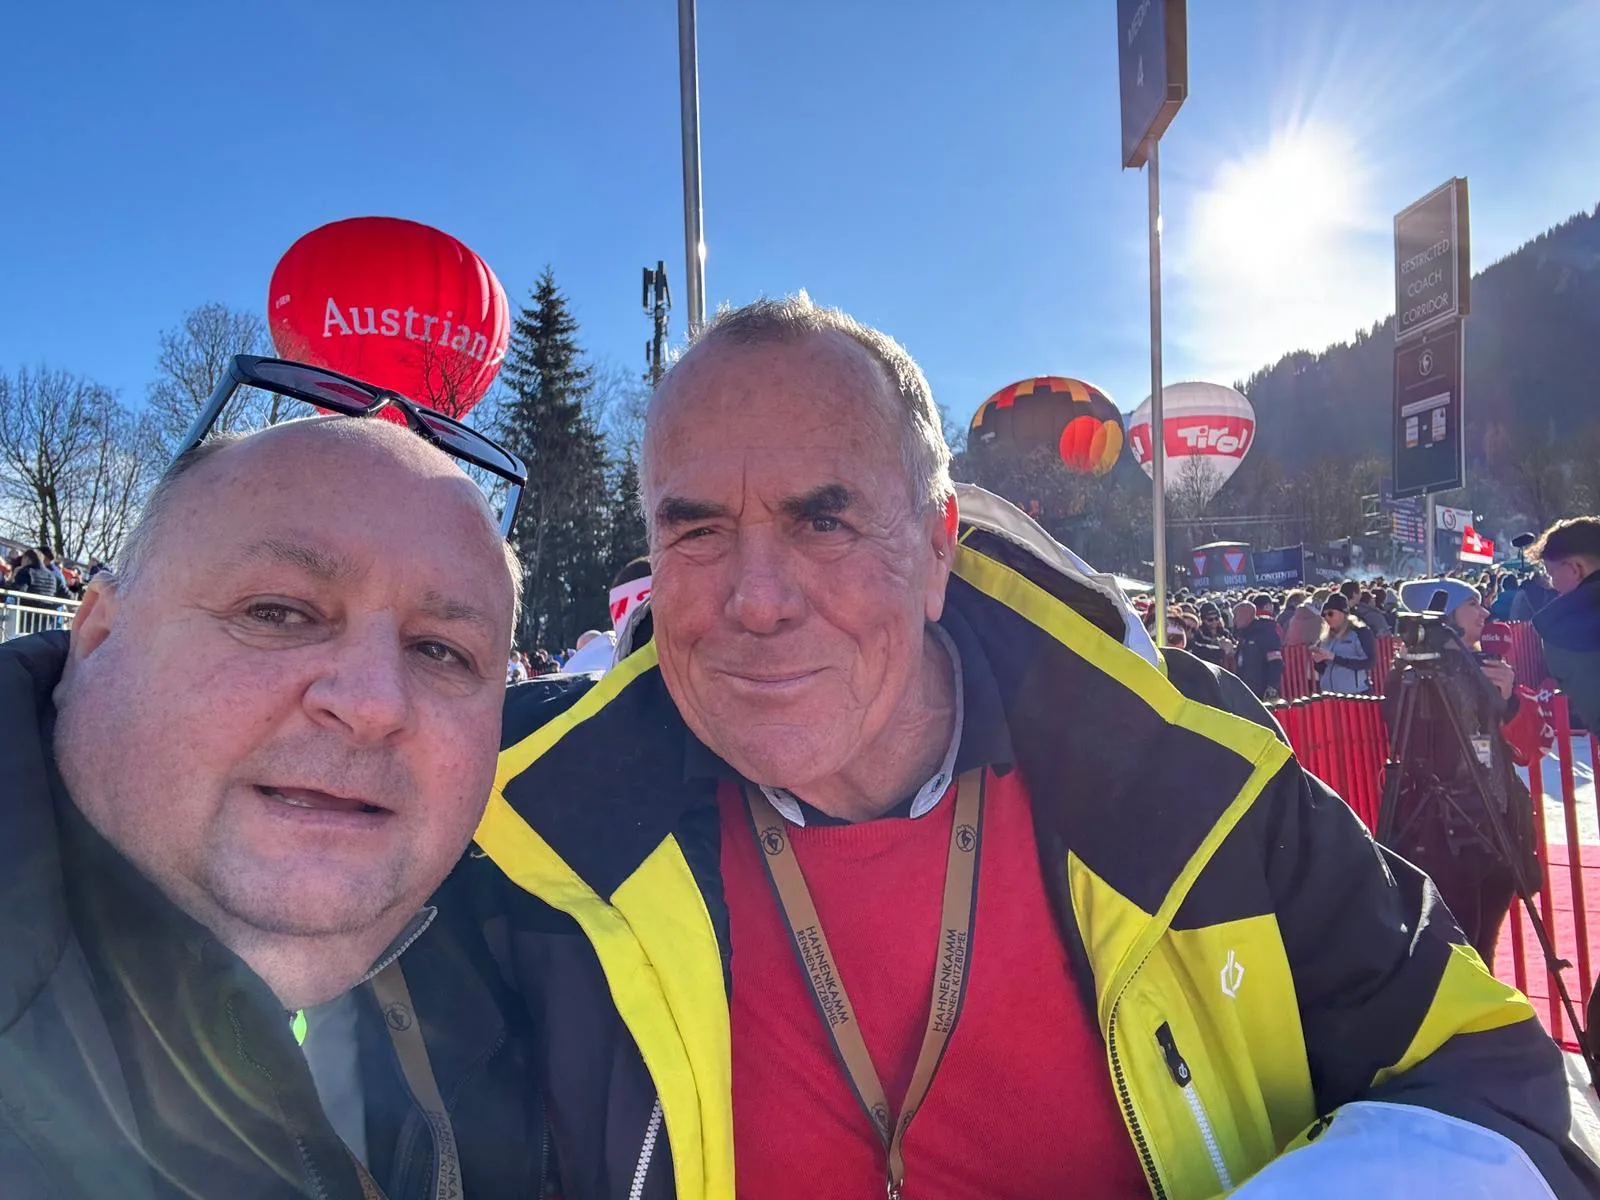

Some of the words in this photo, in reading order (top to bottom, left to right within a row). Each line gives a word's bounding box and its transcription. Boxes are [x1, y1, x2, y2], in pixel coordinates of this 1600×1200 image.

[1401, 239, 1450, 274] RESTRICTED
[1408, 269, 1443, 298] COACH
[322, 297, 488, 362] Austrian
[1402, 292, 1449, 325] CORRIDOR
[1177, 425, 1248, 453] Tirol
[796, 930, 816, 973] RENNEN
[805, 925, 850, 1025] HAHNENKAMM
[932, 929, 957, 1032] HAHNENKAMM
[942, 990, 959, 1033] RENNEN
